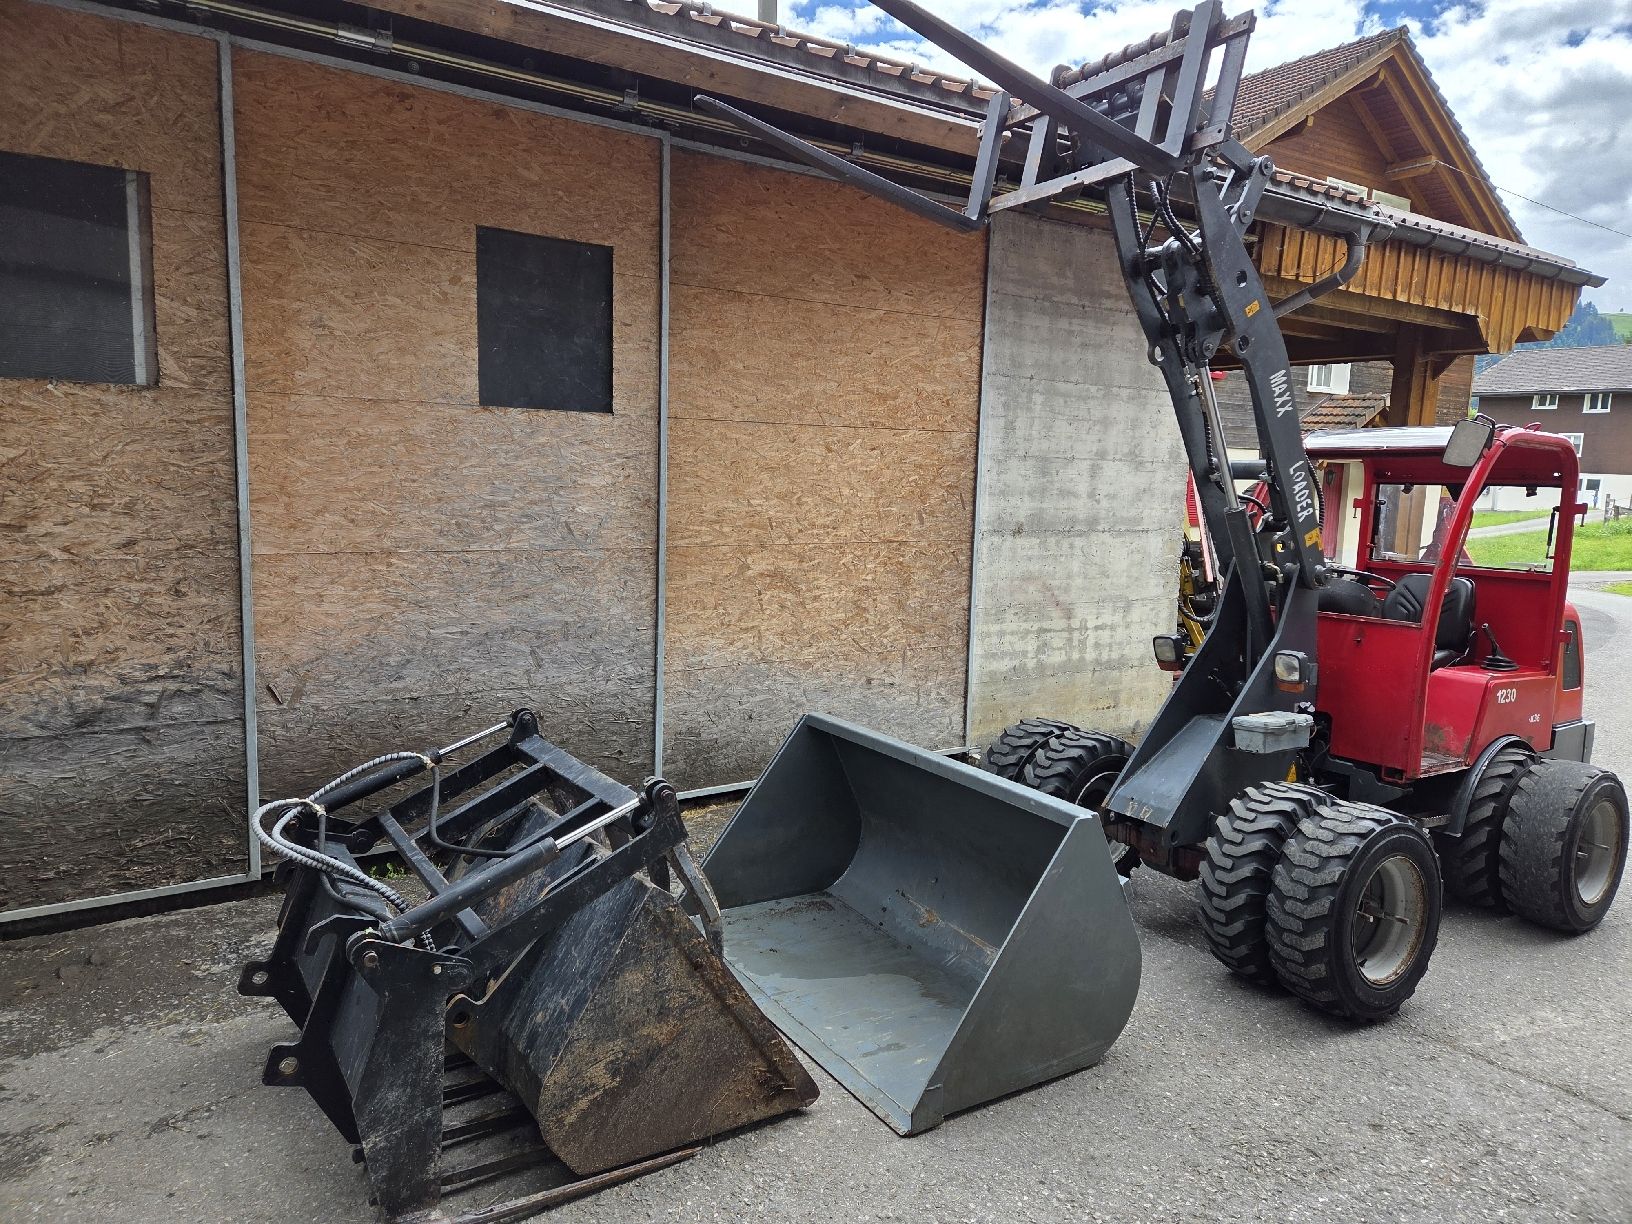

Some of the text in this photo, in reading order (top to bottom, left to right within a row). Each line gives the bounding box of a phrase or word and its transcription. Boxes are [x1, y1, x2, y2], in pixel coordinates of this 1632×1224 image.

[1269, 369, 1313, 522] MAXX LOADER
[1496, 688, 1517, 704] 1230
